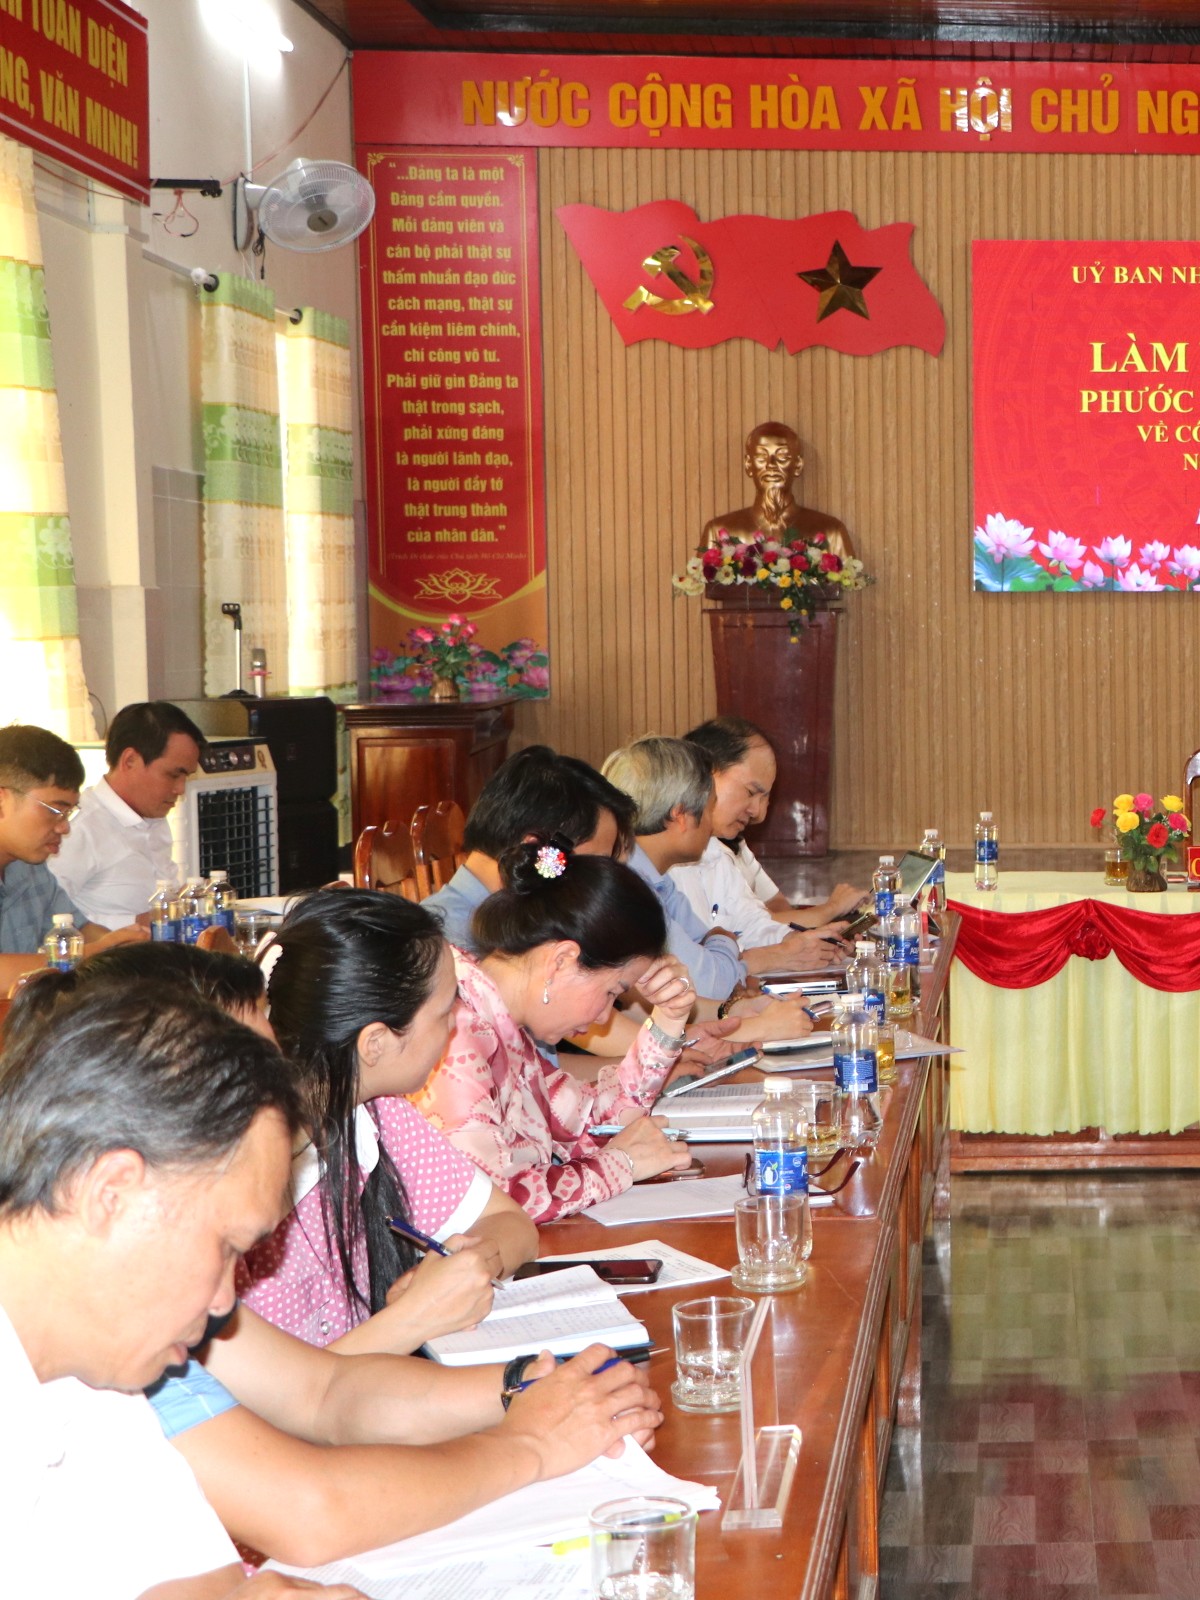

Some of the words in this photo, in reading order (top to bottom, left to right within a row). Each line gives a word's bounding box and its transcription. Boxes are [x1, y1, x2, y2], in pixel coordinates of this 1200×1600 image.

[88, 17, 128, 88] DIỆN
[462, 70, 590, 128] NƯỚC
[608, 74, 732, 138] CỘNG
[750, 76, 841, 131] HÒA
[858, 78, 923, 132] XÃ
[939, 76, 1013, 141] HỘI
[1030, 74, 1119, 134] CHỦ
[40, 69, 80, 139] VĂN
[86, 96, 138, 170] MINH!
[446, 167, 459, 181] ta
[463, 167, 476, 181] là
[479, 167, 505, 184] một
[390, 190, 424, 208] Đảng
[421, 217, 454, 234] đảng
[457, 219, 485, 233] viên
[489, 218, 505, 233] và
[386, 244, 411, 259] cán
[415, 245, 431, 262] bộ
[435, 243, 463, 260] phải
[467, 244, 493, 262] thật
[464, 271, 489, 288] đạo
[1072, 261, 1105, 284] UỶ
[1114, 266, 1163, 284] BAN
[388, 297, 421, 311] cách
[424, 298, 465, 314] mạng,
[469, 297, 494, 314] thật
[497, 298, 513, 314] sự
[410, 322, 443, 340] kiệm
[447, 322, 476, 336] liêm
[404, 348, 425, 363] chí
[429, 348, 461, 364] công
[465, 348, 480, 363] vô
[1089, 332, 1189, 373] LÀM
[387, 373, 416, 388] Phải
[446, 374, 465, 390] gìn
[469, 373, 503, 390] Đảng
[506, 375, 519, 388] ta
[1079, 384, 1194, 413] PHƯỚC
[403, 400, 428, 417] thật
[432, 401, 465, 415] trong
[470, 400, 505, 417] sạch,
[404, 424, 432, 441] phải
[472, 425, 505, 441] đáng
[1136, 420, 1169, 443] VỀ
[397, 451, 409, 466] là
[413, 452, 449, 467] người
[453, 451, 481, 466] lãnh
[485, 451, 513, 468] đạo,
[408, 477, 420, 491] là
[424, 477, 460, 493] người
[404, 502, 430, 519] thật
[434, 503, 467, 518] trung
[471, 502, 508, 517] thành
[407, 527, 431, 543] của
[435, 528, 467, 542] nhân
